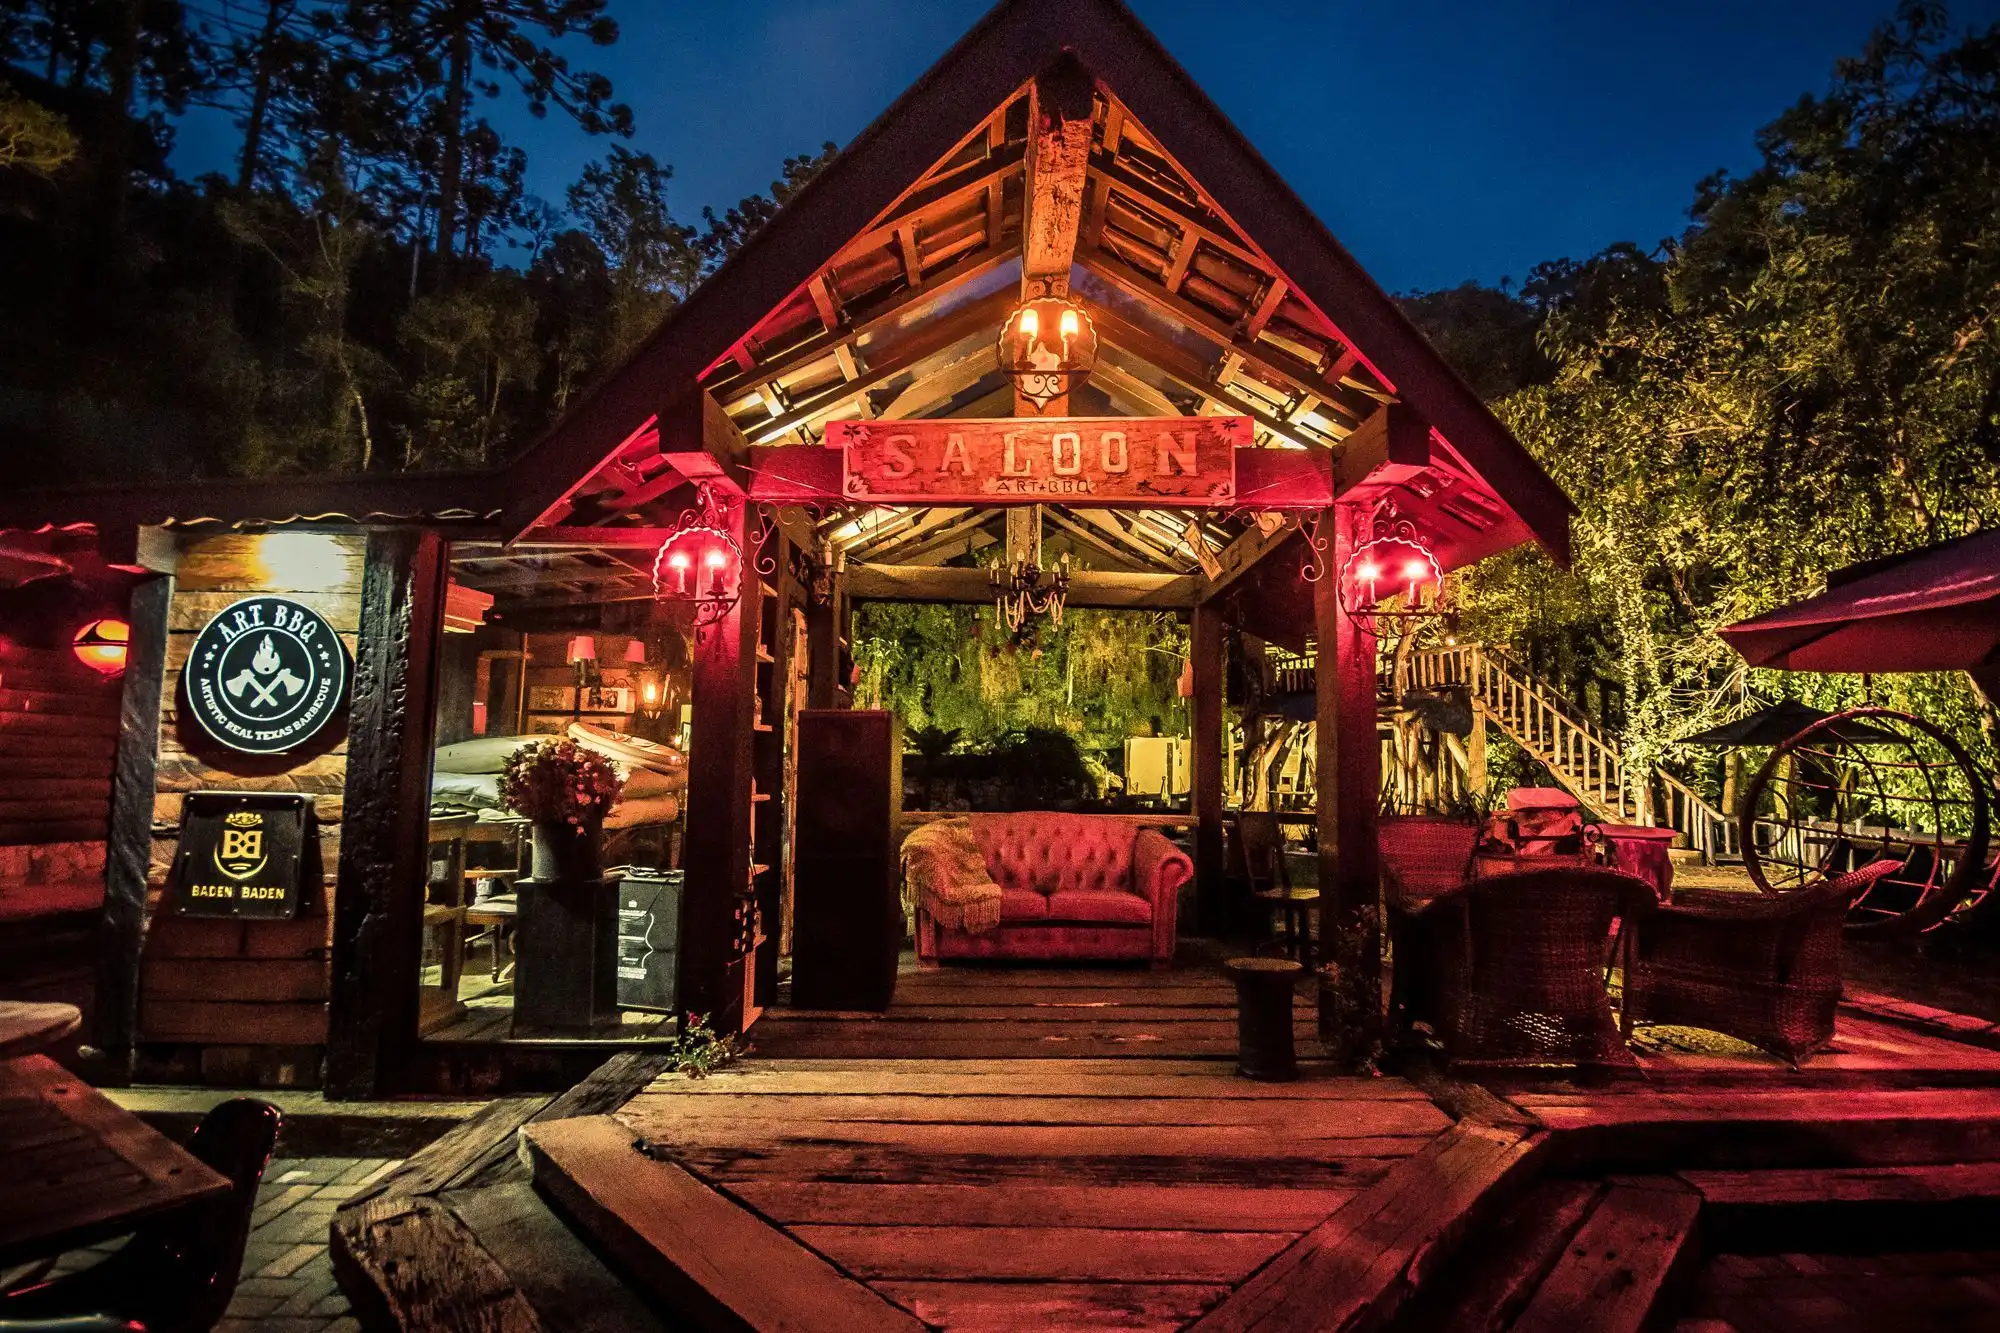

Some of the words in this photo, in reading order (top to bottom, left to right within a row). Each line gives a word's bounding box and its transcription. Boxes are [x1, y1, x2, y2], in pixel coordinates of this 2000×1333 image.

[882, 431, 1200, 478] SALOON
[996, 481, 1037, 493] ART
[1048, 479, 1092, 495] BBQ
[217, 604, 265, 643] ART
[273, 605, 318, 643] BBQ
[200, 678, 227, 724] ARTISTIC
[225, 722, 254, 740] REAL
[254, 725, 293, 741] TEXAS
[294, 677, 332, 731] BARBECUE
[191, 885, 233, 898] BADEN
[241, 886, 285, 900] BADEN
